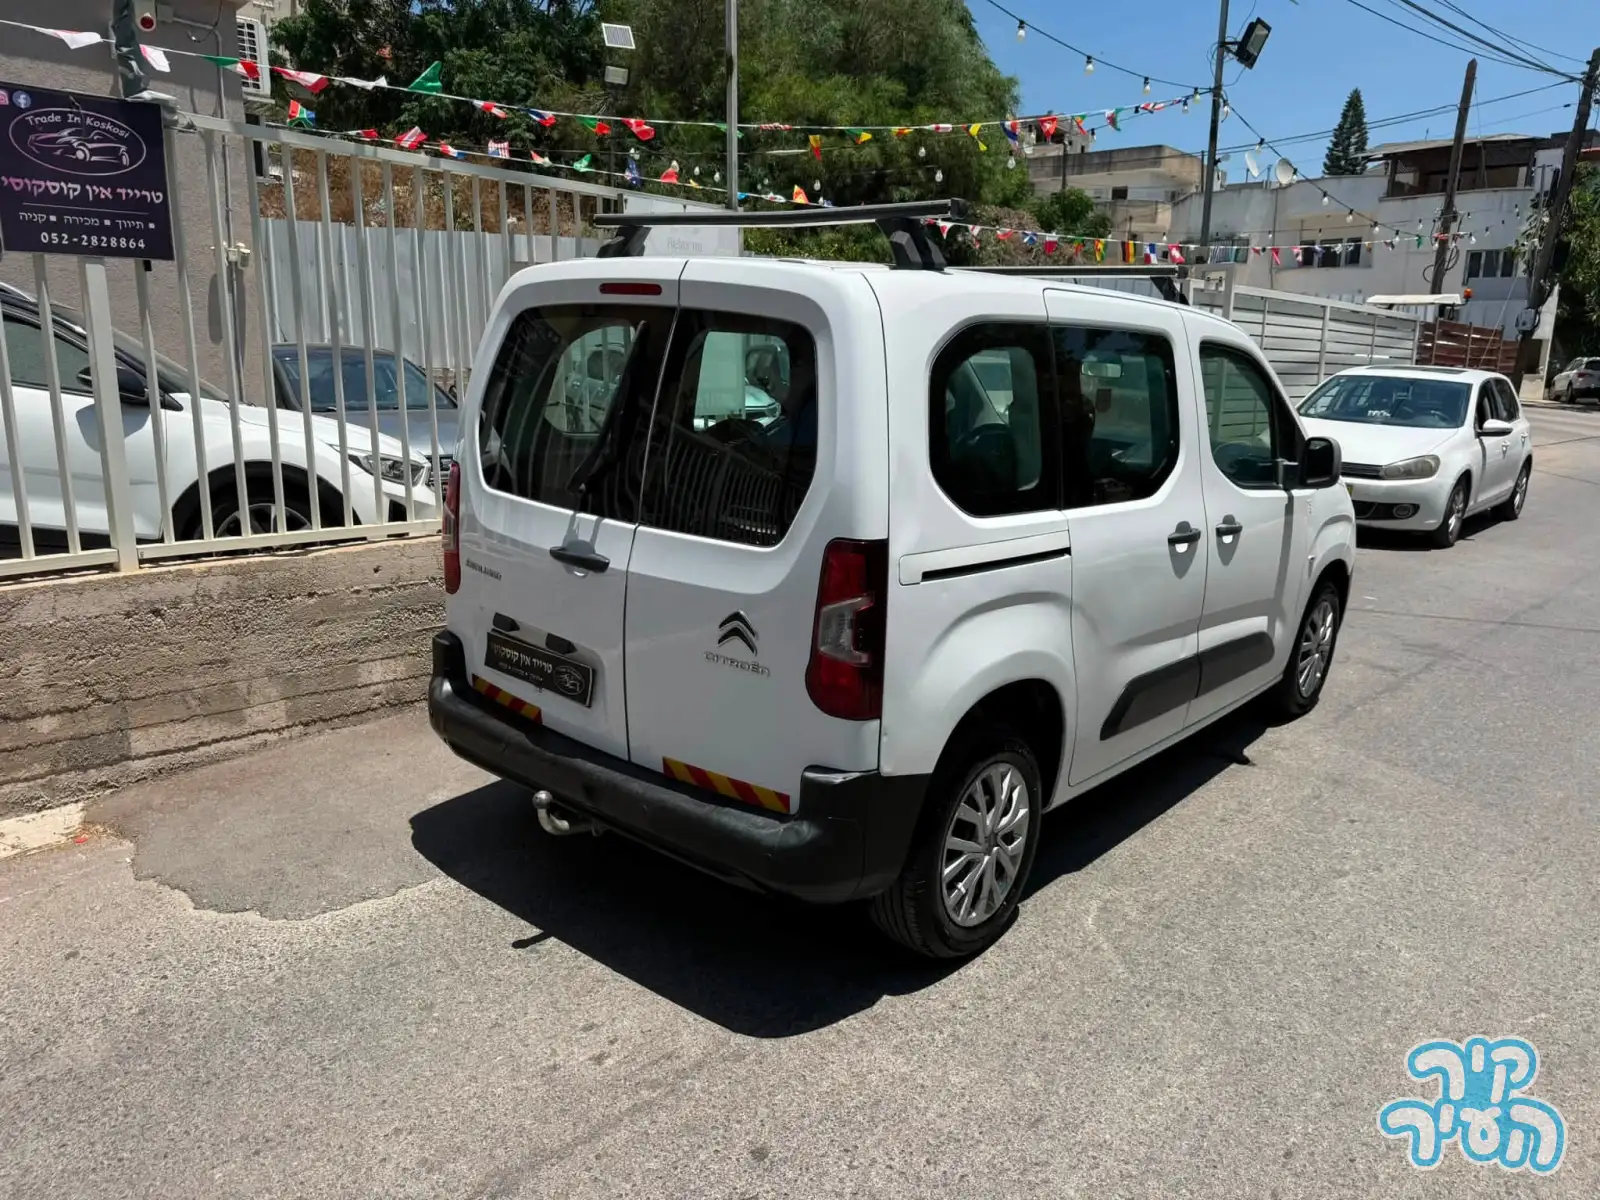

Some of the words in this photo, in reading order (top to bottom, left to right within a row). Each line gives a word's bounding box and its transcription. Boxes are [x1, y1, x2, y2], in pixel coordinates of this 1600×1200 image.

[25, 113, 62, 126] Trade
[66, 113, 81, 123] In
[86, 117, 130, 138] Koskosi
[1, 175, 81, 200] קוסקוסי
[86, 185, 113, 201] אין
[116, 188, 164, 204] טרייד
[18, 212, 47, 223] קניה
[63, 215, 100, 226] מכירה
[115, 219, 144, 230] תיווך
[40, 231, 146, 249] 052-2828864
